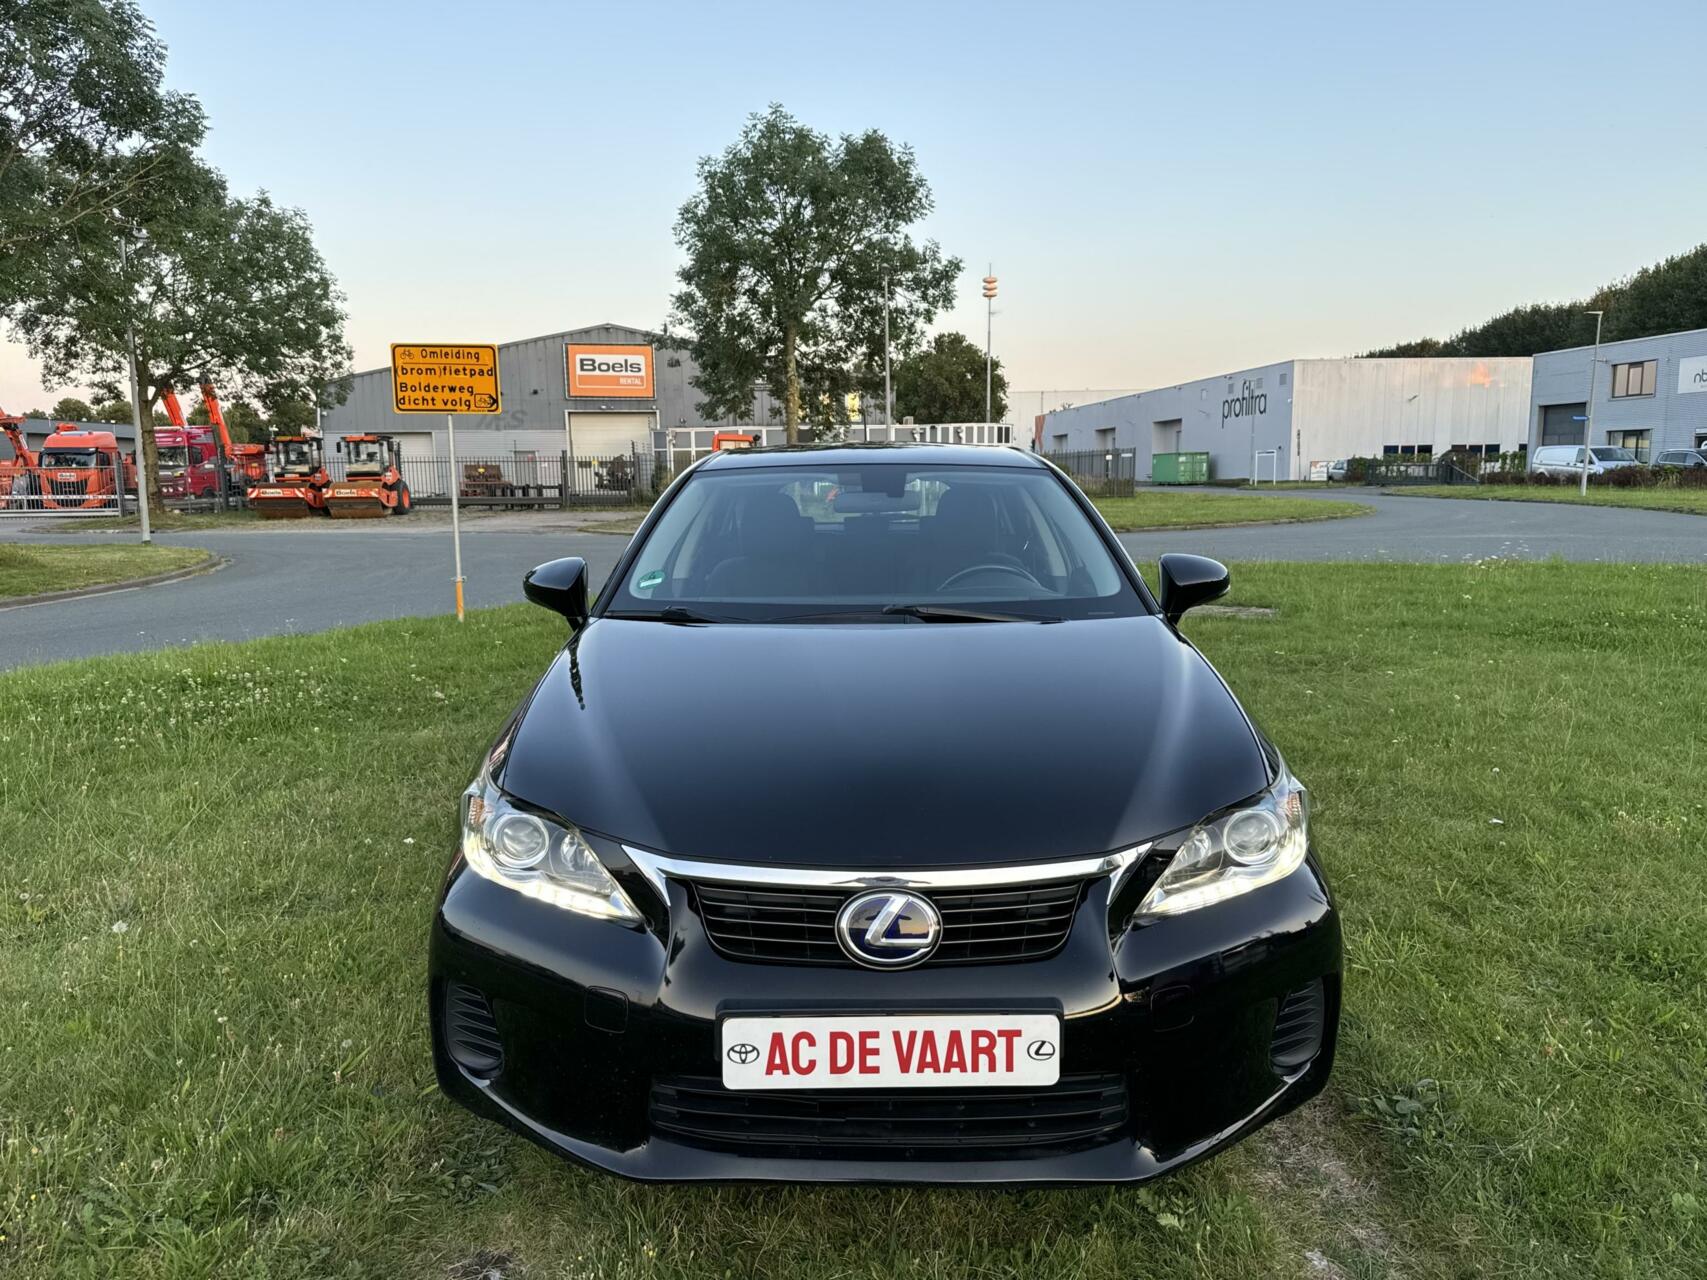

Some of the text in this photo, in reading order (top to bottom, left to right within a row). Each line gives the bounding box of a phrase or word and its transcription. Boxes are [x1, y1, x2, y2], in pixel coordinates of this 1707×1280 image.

[420, 348, 480, 362] Omleiding
[579, 358, 642, 373] Boels
[399, 382, 474, 396] Bolderweg
[398, 396, 471, 410] dicht volg
[1221, 380, 1267, 429] profiltra
[765, 1029, 1022, 1076] AC DE VAART
